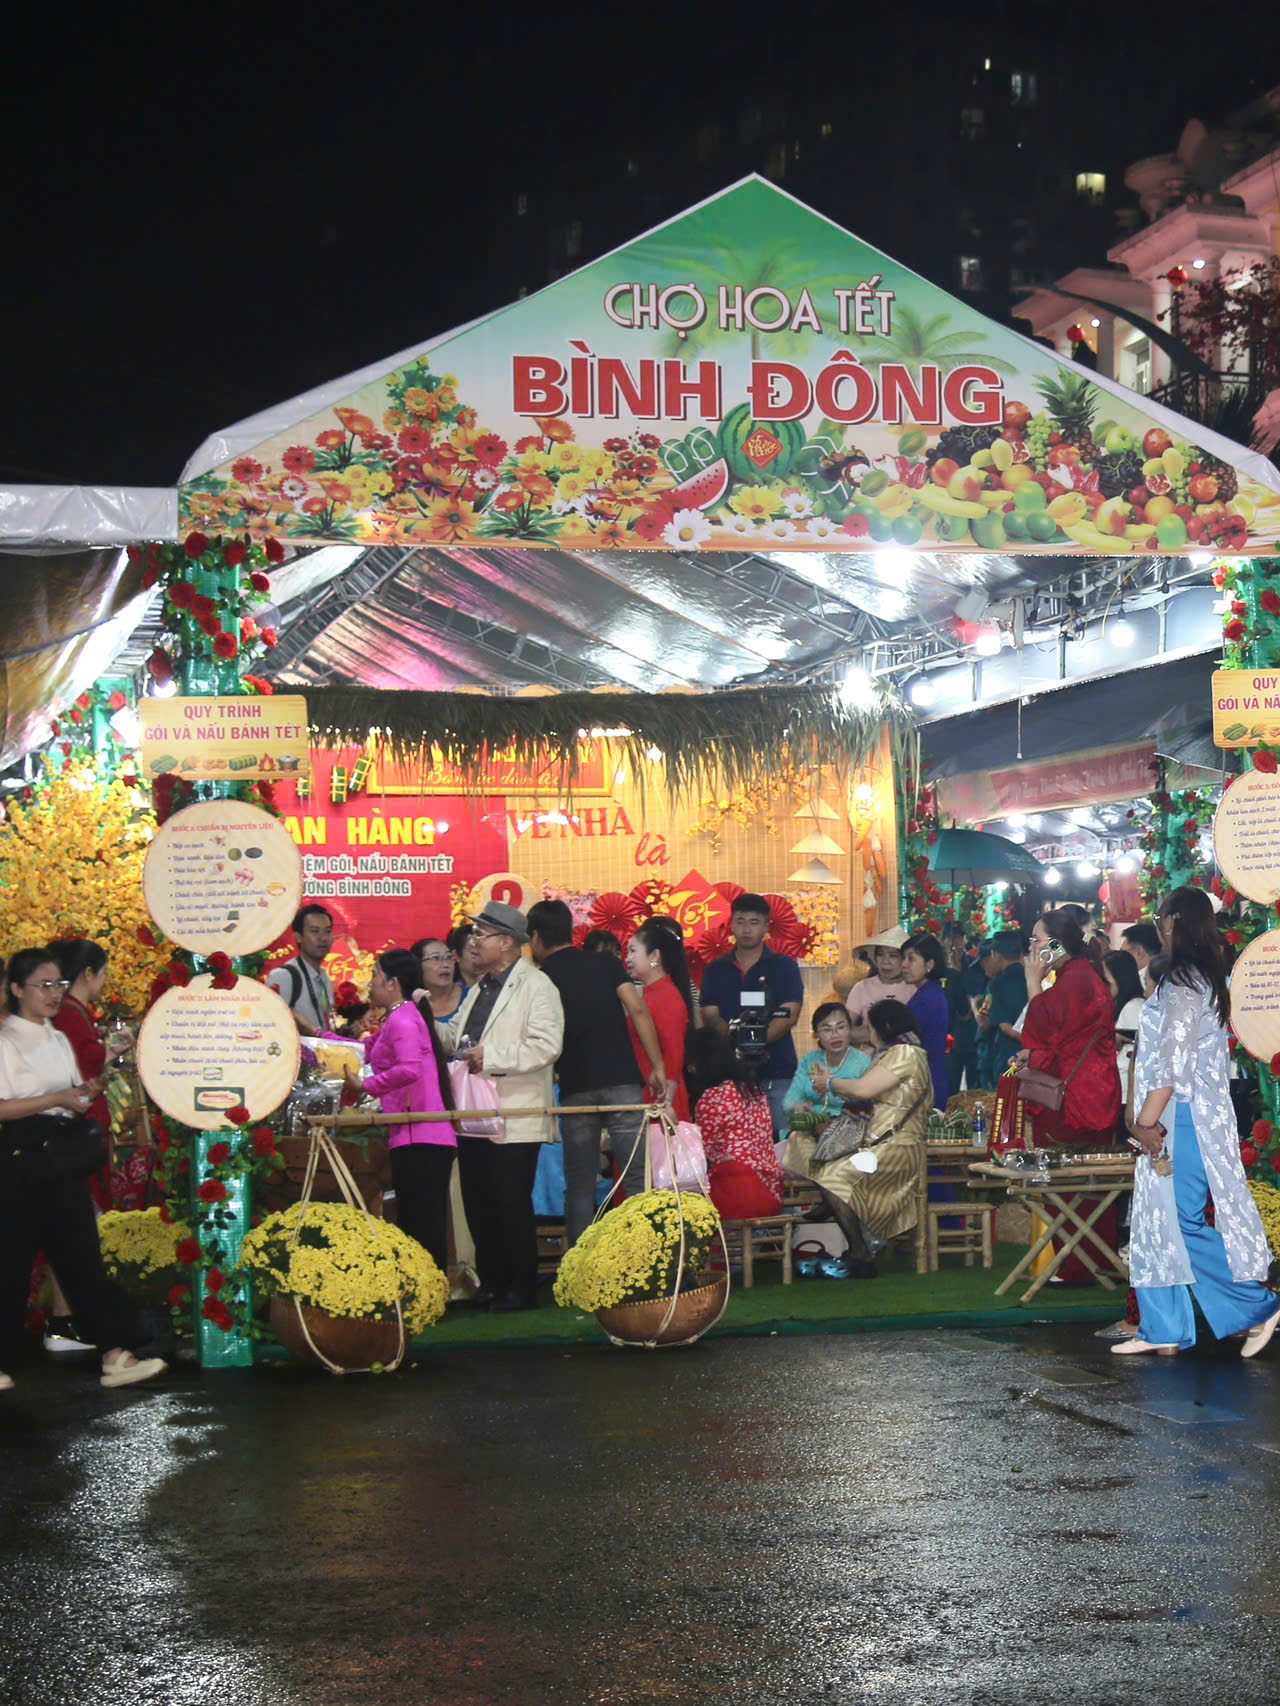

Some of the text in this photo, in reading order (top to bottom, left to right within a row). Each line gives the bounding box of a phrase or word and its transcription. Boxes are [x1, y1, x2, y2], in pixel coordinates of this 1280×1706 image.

[603, 274, 896, 339] CHỢ HOA TẾT
[511, 339, 1004, 426] BÌNH ĐÔNG
[1252, 677, 1279, 691] QUY
[184, 702, 262, 721] QUY TRÌNH
[1217, 694, 1239, 712] GÓI
[1243, 694, 1260, 710] VÀ
[144, 723, 168, 740] GÓI
[173, 724, 191, 740] VÀ
[196, 721, 226, 740] NẤU
[231, 722, 270, 740] BÁNH
[347, 807, 436, 845] HÀNG
[560, 800, 636, 838] NHÀ
[634, 831, 672, 867] là
[330, 854, 356, 875] GÓI,
[359, 852, 387, 873] NẤU
[391, 853, 427, 873] BÁNH
[430, 853, 452, 872] TÉT
[339, 877, 370, 895] BÌNH
[374, 877, 410, 895] ĐÔNG
